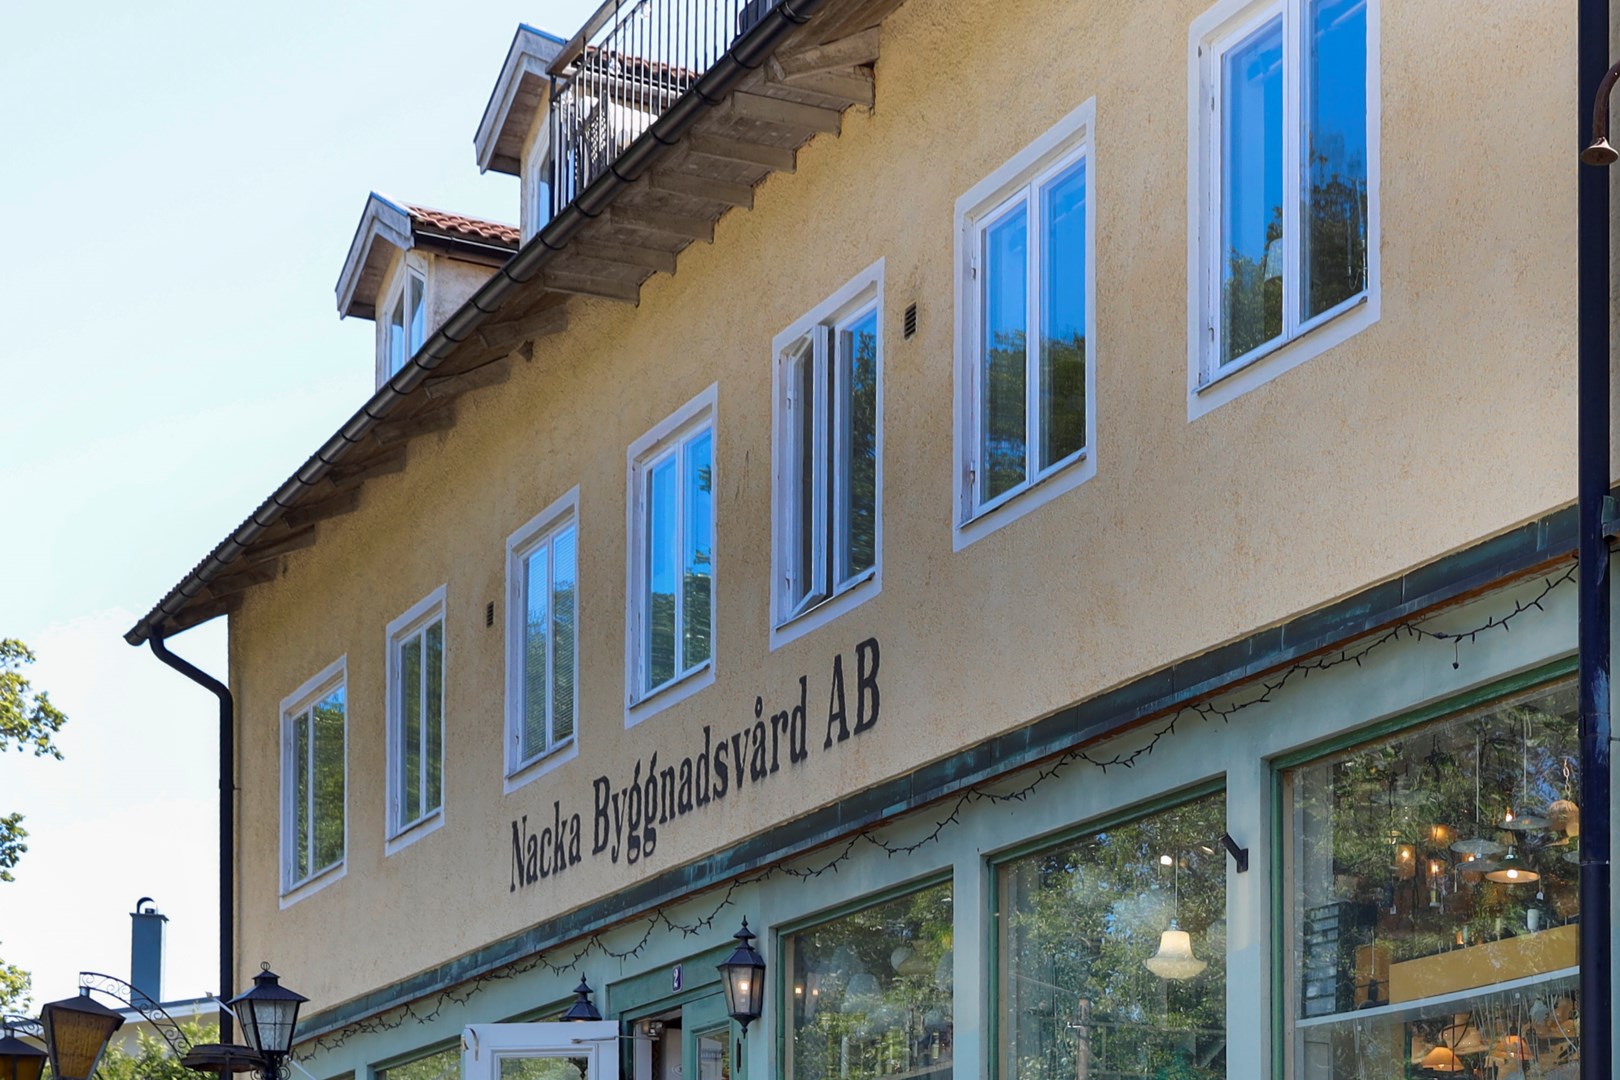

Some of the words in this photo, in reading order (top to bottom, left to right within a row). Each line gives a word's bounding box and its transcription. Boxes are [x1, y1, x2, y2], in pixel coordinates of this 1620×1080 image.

[510, 800, 582, 892] Nacka
[592, 675, 808, 865] Byggnadsvård
[824, 636, 880, 750] AB
